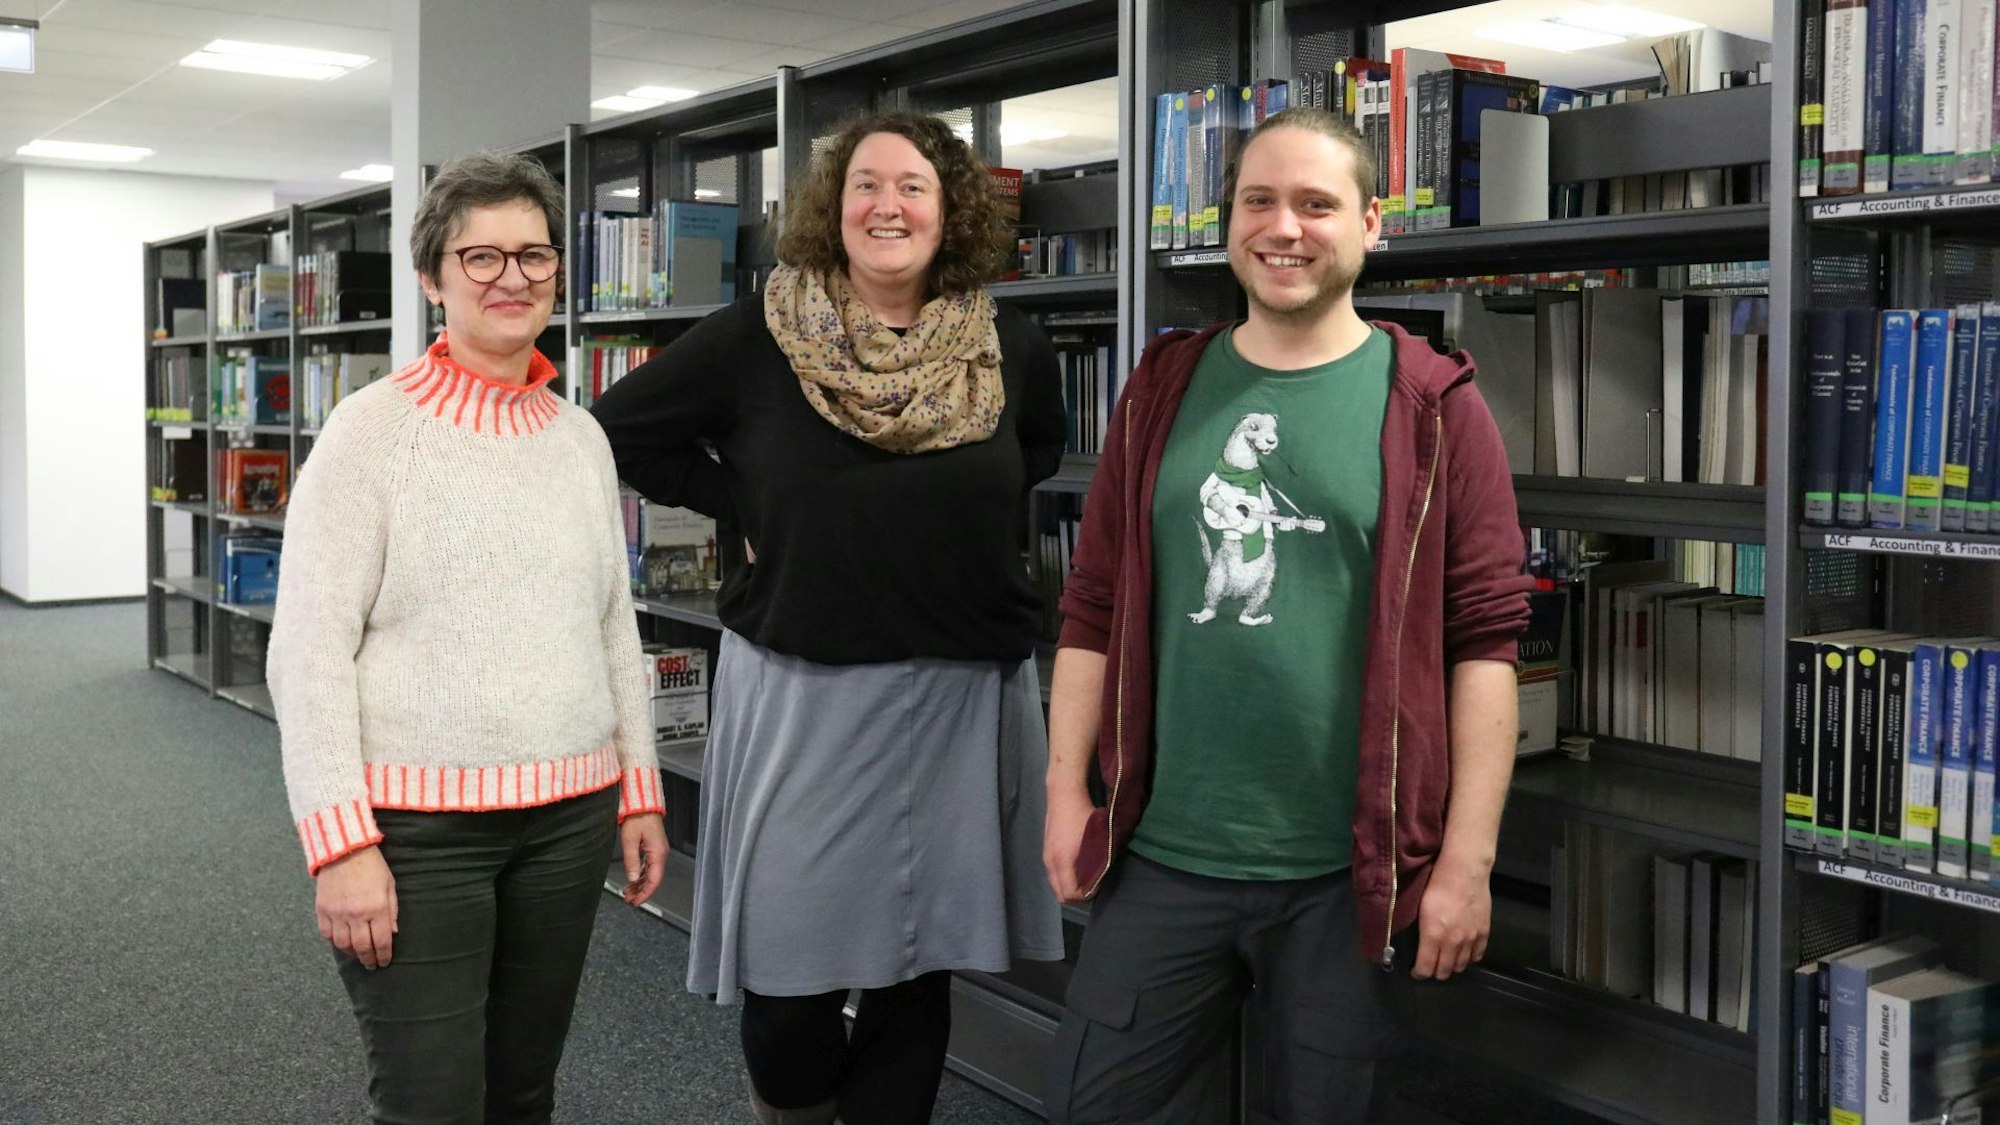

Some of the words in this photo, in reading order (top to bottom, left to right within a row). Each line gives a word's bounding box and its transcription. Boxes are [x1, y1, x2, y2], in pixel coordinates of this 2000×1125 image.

[1833, 26, 1842, 80] FINANCIAL
[1843, 12, 1854, 69] TECHNICAL
[1937, 24, 1951, 80] CORPORATE
[1874, 53, 1886, 97] Management
[1830, 85, 1841, 137] MARKETS
[1841, 70, 1852, 122] ANALYSIS
[1935, 85, 1949, 127] FINANCE
[1819, 203, 1842, 215] ACF
[1860, 197, 1930, 213] Accounting
[1934, 196, 1945, 207] &
[1948, 192, 2000, 206] Finance
[1174, 255, 1186, 263] ACF
[1958, 350, 1969, 387] Essentials
[1984, 346, 1997, 386] Essentials
[1889, 364, 1901, 410] Fundamentals
[1925, 365, 1936, 409] Fundamentals
[1886, 417, 1897, 454] CORPORATE
[1922, 418, 1933, 454] CORPORATE
[1953, 399, 1966, 440] Corporate
[1979, 397, 1993, 438] Corporate
[1885, 455, 1895, 481] FINANCE
[1921, 455, 1930, 476] FINAN
[1951, 441, 1962, 464] Finan
[1976, 440, 1989, 473] Finance
[1829, 535, 1852, 546] ACF
[1870, 538, 1941, 555] Accounting
[1945, 541, 1956, 554] &
[657, 655, 688, 674] COST
[660, 669, 701, 690] EFFECT
[1794, 683, 1802, 729] FUNDAMENTALS
[1800, 684, 1808, 718] CORPORATE
[1832, 686, 1840, 721] CORPORATE
[1921, 659, 1931, 712] CORPORATE
[1953, 668, 1964, 716] ORPORATE
[1986, 664, 1997, 718] CORPORATE
[1859, 688, 1867, 735] FUNDAMENTALS
[1865, 689, 1873, 725] CORPORATE
[1887, 694, 1895, 742] FUNDAMENTALS
[1893, 694, 1901, 732] CORPORATE
[1892, 734, 1900, 760] FINANCE
[1918, 713, 1930, 754] FINANCE
[1951, 717, 1963, 759] FINANCE
[1983, 720, 1995, 762] FINANCE
[1823, 862, 1847, 875] ACF
[1865, 869, 1935, 898] Accounting
[1939, 885, 1950, 898] &
[1954, 887, 2000, 910] Financ
[1879, 1004, 1891, 1048] Finance
[1846, 1025, 1861, 1103] international
[1878, 1049, 1892, 1104] Corporate
[1832, 1081, 1844, 1106] equ
